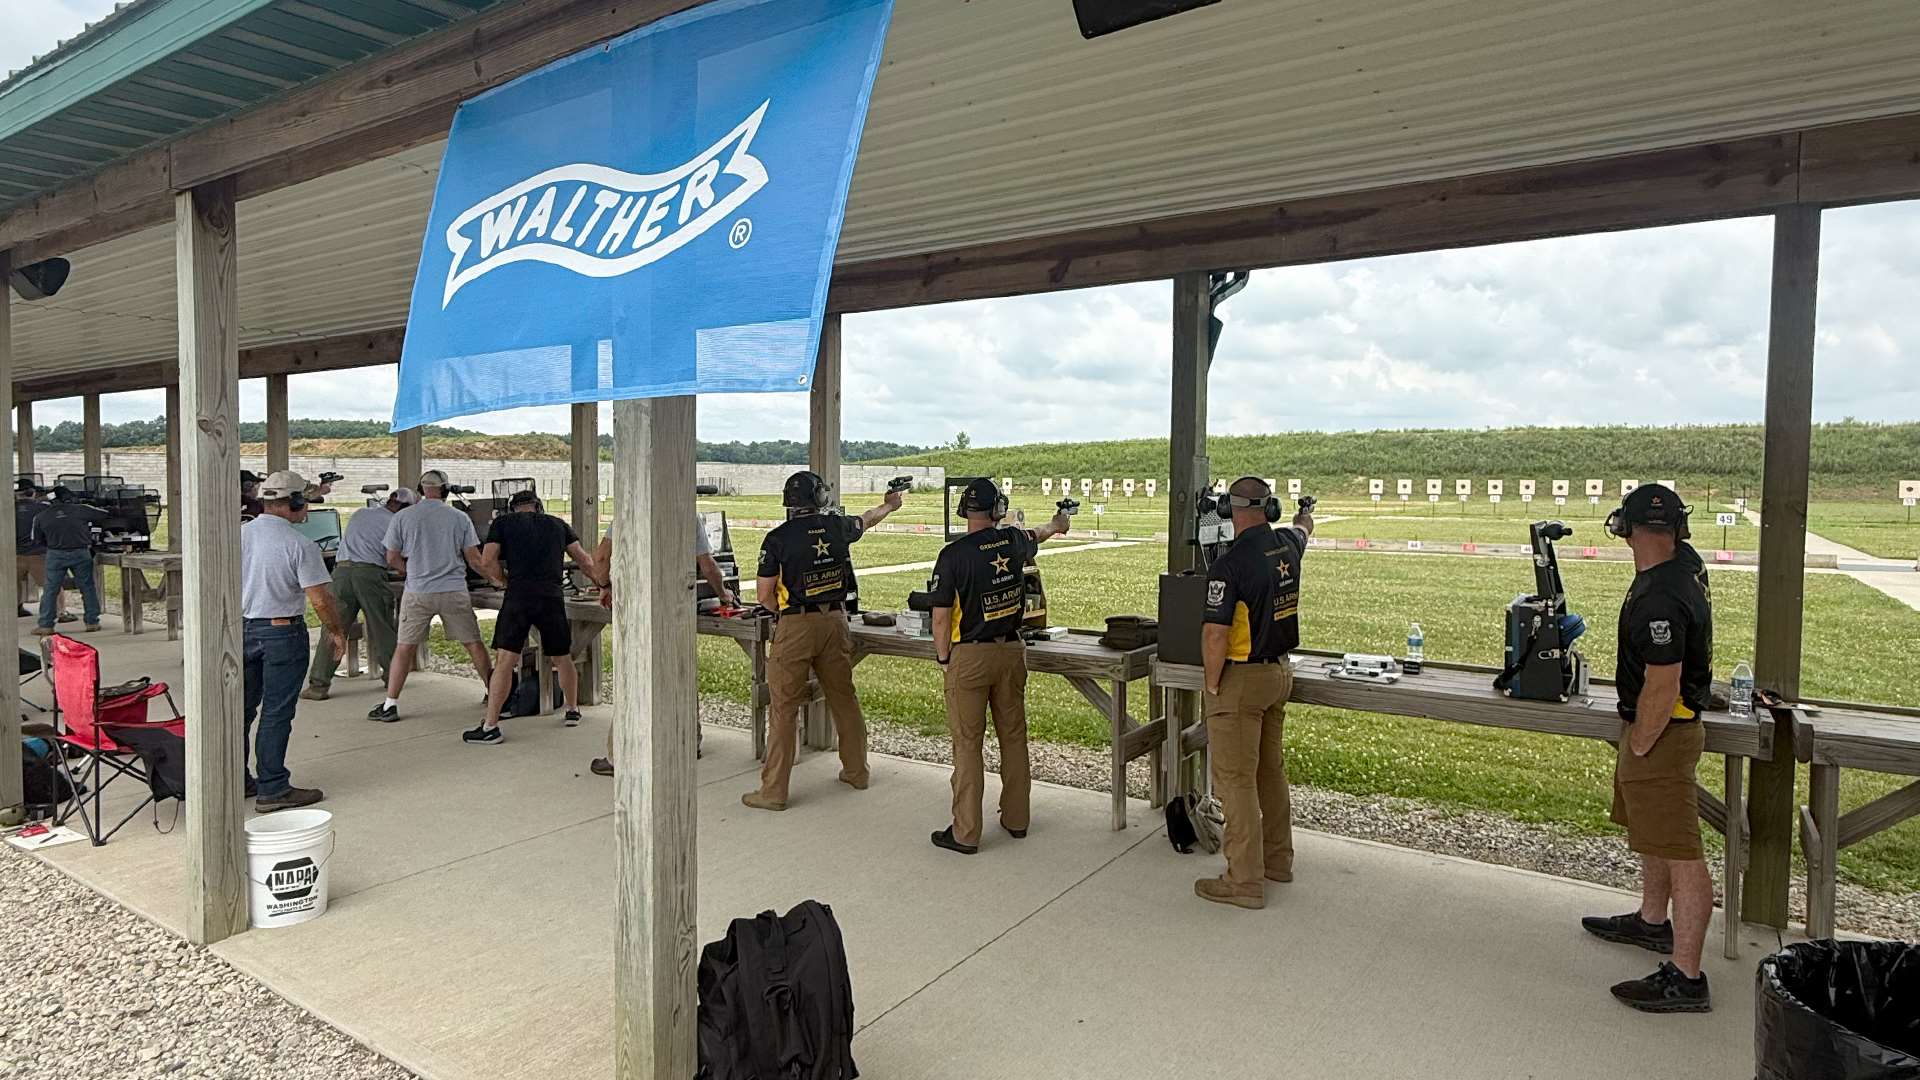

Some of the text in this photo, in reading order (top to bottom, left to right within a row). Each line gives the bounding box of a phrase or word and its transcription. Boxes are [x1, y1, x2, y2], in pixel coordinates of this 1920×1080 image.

[481, 159, 720, 259] WALTHER
[1719, 515, 1733, 524] 49
[820, 567, 842, 580] ARMY
[983, 594, 1001, 606] U.S.
[274, 866, 312, 886] NAPA
[266, 894, 318, 910] WASHINGTON
